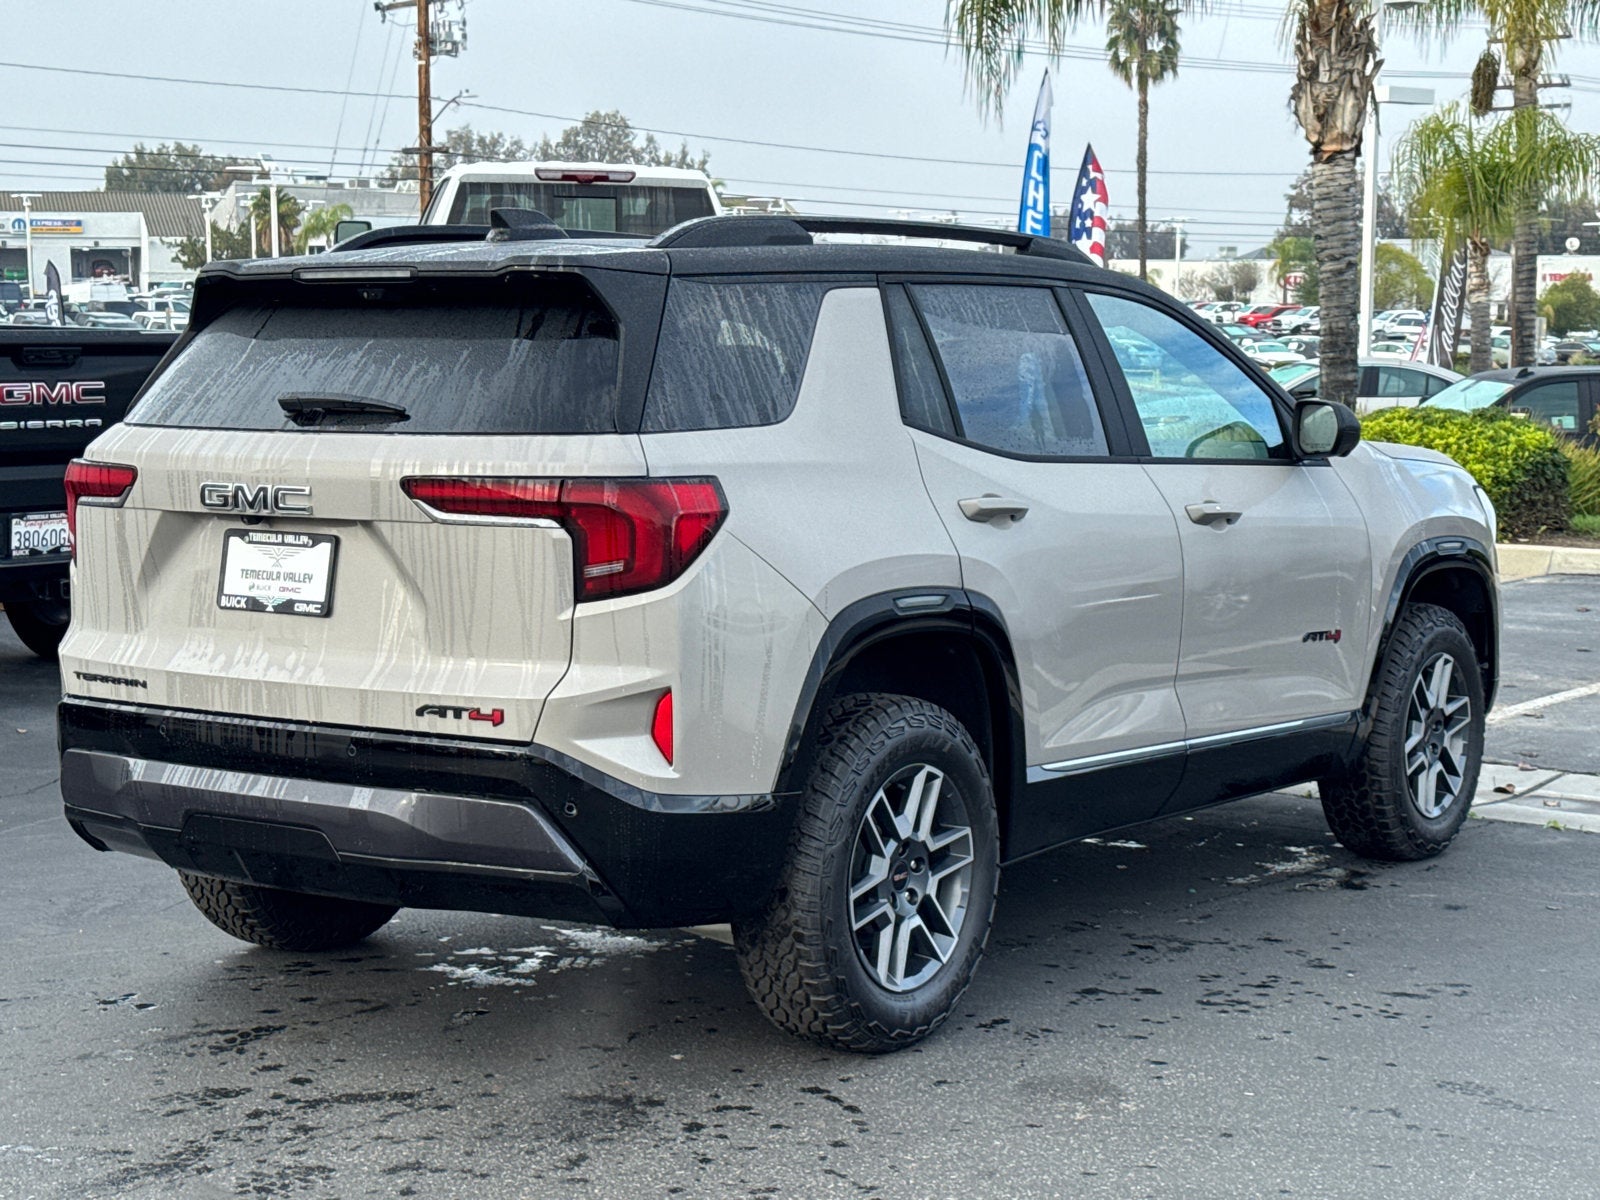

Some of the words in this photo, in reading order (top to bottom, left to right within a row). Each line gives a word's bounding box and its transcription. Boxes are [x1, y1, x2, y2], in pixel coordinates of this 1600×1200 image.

[0, 381, 105, 406] GMC
[0, 418, 102, 430] SIERRA
[200, 481, 312, 515] GMC
[249, 532, 282, 543] TEMECULA
[284, 534, 309, 545] VALLEY
[241, 568, 281, 581] TEMECULA
[283, 571, 313, 583] VALLEY
[279, 586, 302, 594] GMC
[220, 595, 248, 608] BUICK
[294, 602, 322, 613] GMC
[1302, 629, 1342, 644] AT4
[73, 671, 148, 689] TERRAIN
[415, 704, 504, 727] AT4
